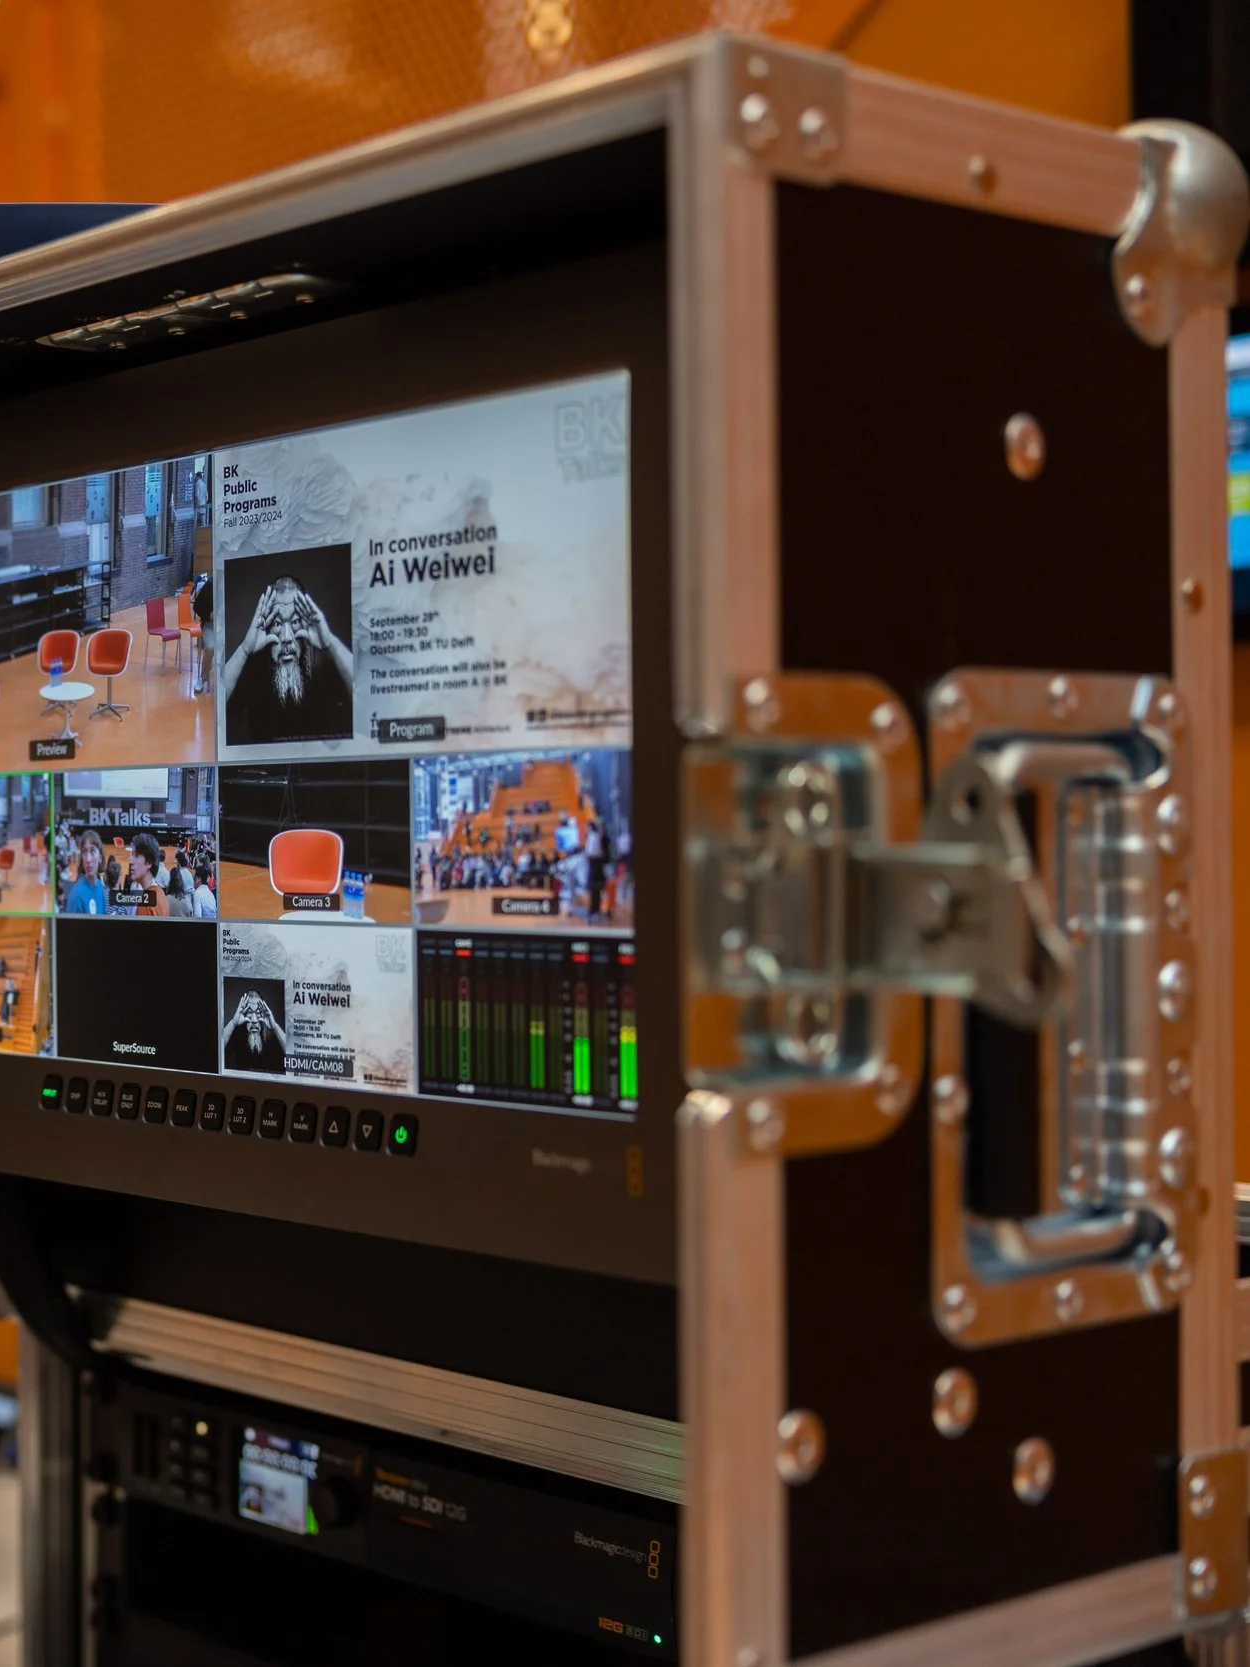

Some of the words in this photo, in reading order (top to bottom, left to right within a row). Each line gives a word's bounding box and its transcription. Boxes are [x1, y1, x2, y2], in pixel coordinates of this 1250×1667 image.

[223, 464, 239, 479] BK
[223, 479, 257, 497] Public
[223, 495, 277, 514] Programs
[223, 516, 237, 528] Fall
[239, 510, 283, 526] 2023/2024
[369, 538, 383, 556] In
[388, 525, 497, 554] conversation
[369, 560, 394, 588] Ai
[402, 546, 495, 584] Weiwei
[370, 614, 419, 629] September
[370, 669, 386, 679] The
[389, 665, 449, 678] conversation
[452, 662, 468, 673] will
[370, 681, 429, 695] livestreamed
[389, 721, 434, 740] Program
[37, 742, 68, 757] Preview
[89, 807, 111, 826] BK
[112, 808, 150, 826] Talks
[116, 892, 142, 903] Camera
[143, 893, 149, 904] 2
[292, 896, 323, 907] Camera
[324, 896, 331, 908] 3
[501, 898, 539, 913] Camera
[223, 938, 240, 946] Public
[223, 947, 249, 955] Programs
[292, 980, 300, 989] In
[302, 981, 351, 992] conversation
[293, 993, 305, 1005] Ai
[309, 993, 351, 1008] Weiwei
[112, 1040, 156, 1055] SuperSource
[284, 1057, 344, 1073] HDMI/CAM08
[175, 1104, 188, 1112] PEAK
[262, 1119, 278, 1127] MARK
[293, 1122, 309, 1130] MARK
[598, 1616, 624, 1634] 12G
